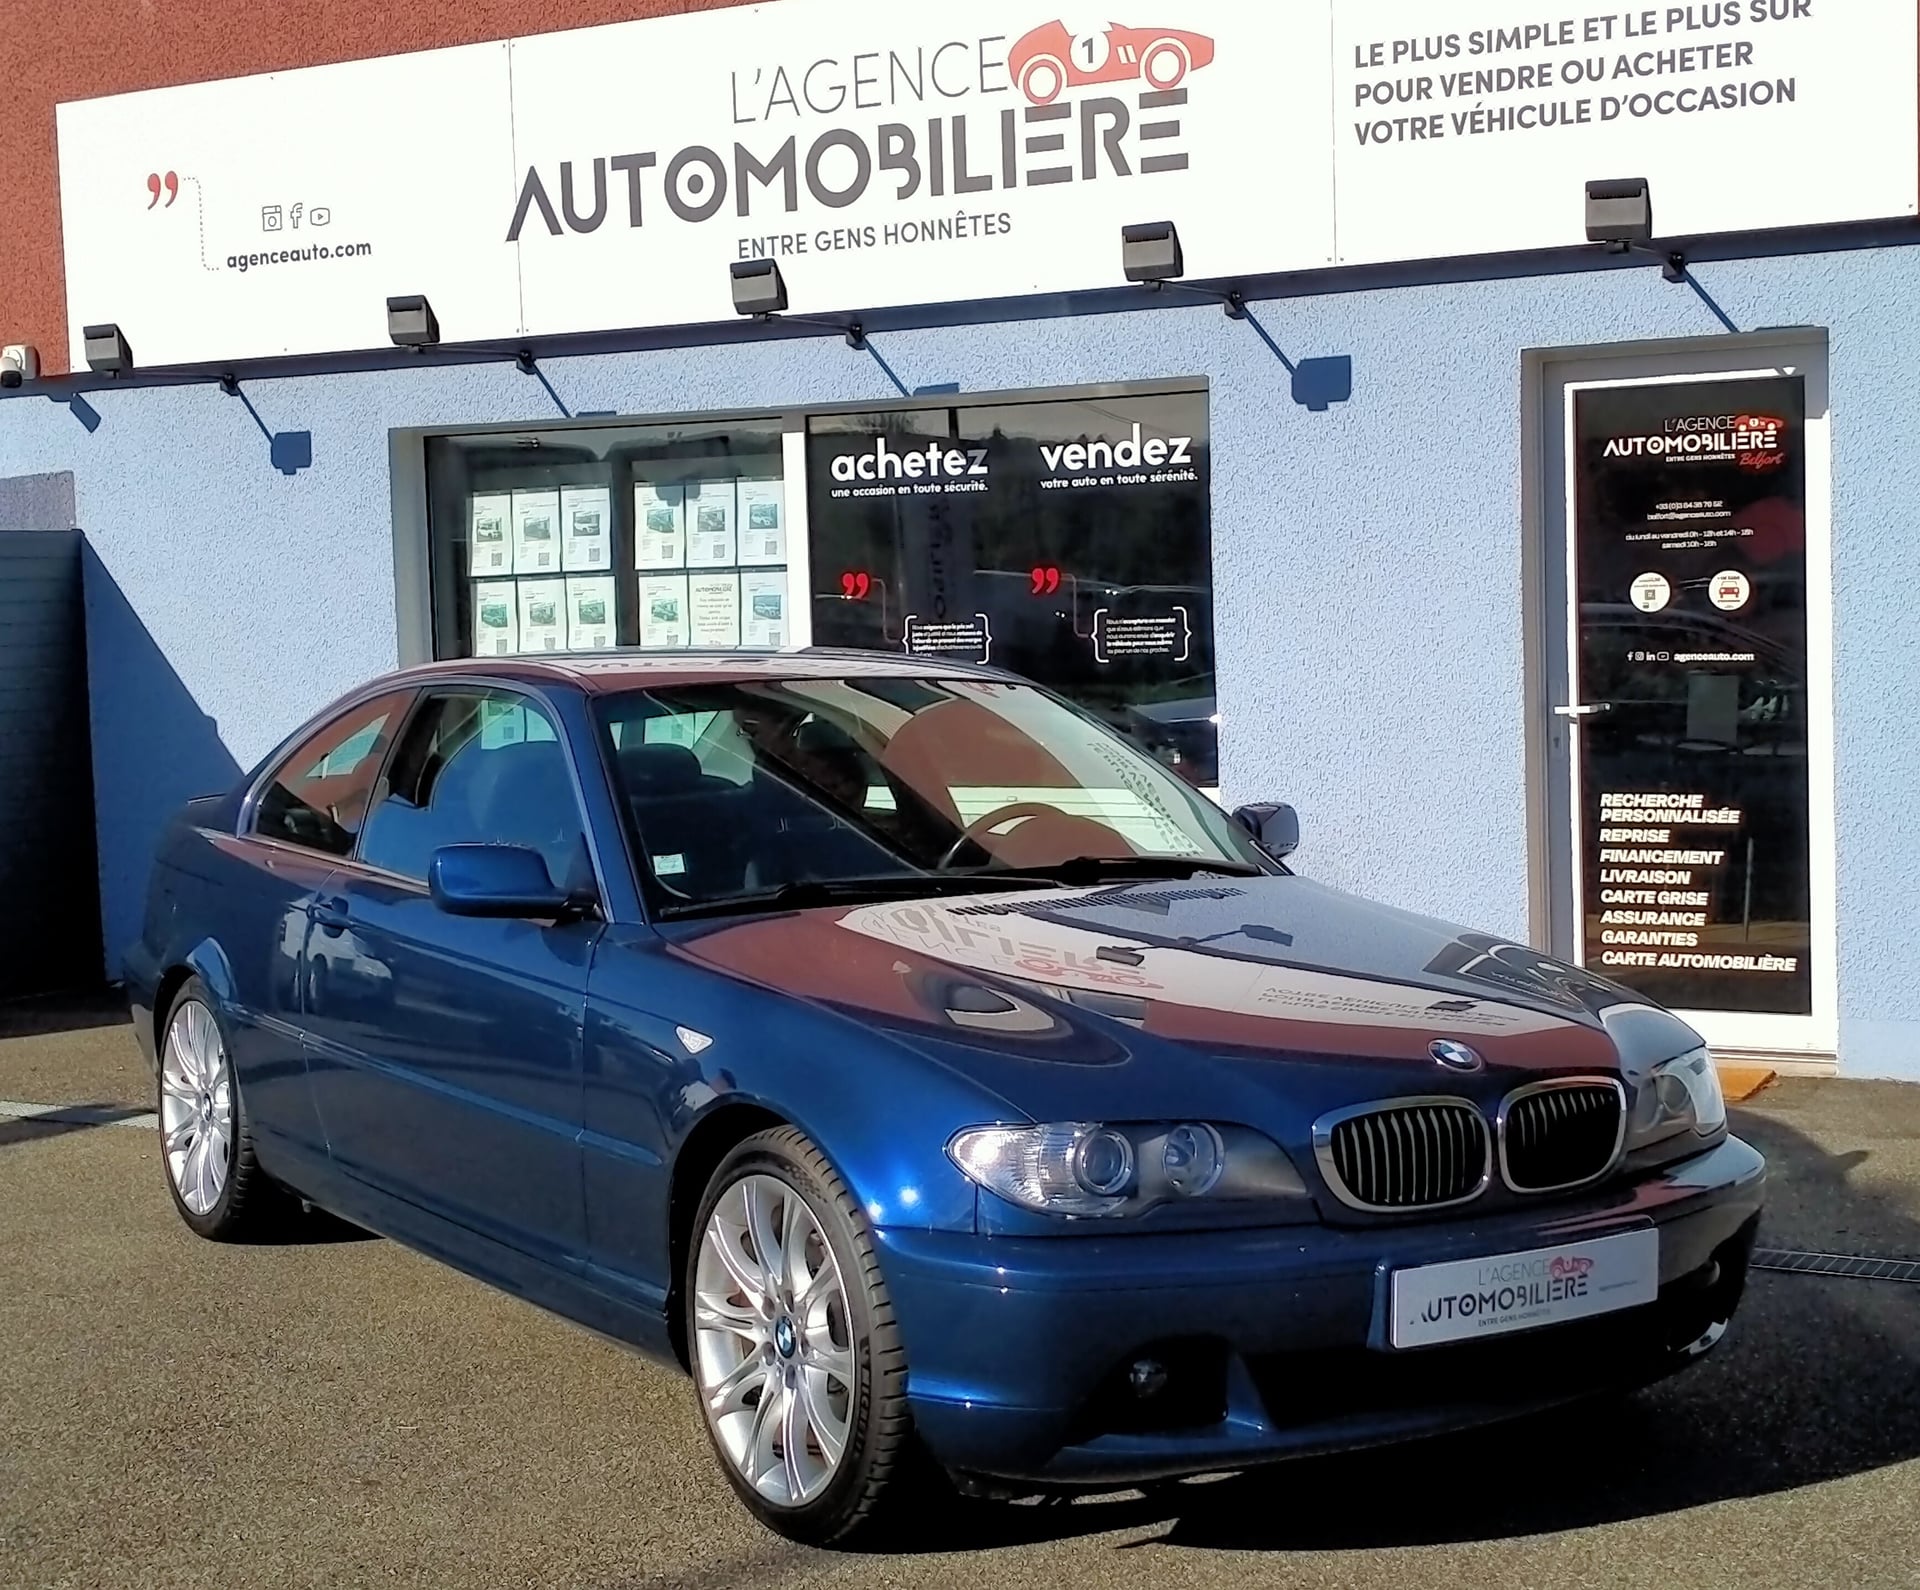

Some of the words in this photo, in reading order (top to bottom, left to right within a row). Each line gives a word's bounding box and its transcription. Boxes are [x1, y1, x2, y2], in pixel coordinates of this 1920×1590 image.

[1355, 42, 1385, 69] LE
[1392, 34, 1461, 65] PLUS
[1469, 20, 1575, 56] SIMPLE
[1584, 14, 1618, 43] ET
[1625, 11, 1658, 38] LE
[1667, 1, 1741, 33] PLUS
[1750, 0, 1812, 23] SUR
[1082, 37, 1094, 64] 1
[731, 36, 1008, 124] L'AGENCE
[1355, 77, 1433, 108] POUR
[1439, 62, 1553, 98] VENDRE
[1560, 57, 1605, 86] OU
[1611, 42, 1754, 81] ACHETER
[1354, 114, 1445, 146] VOTRE
[1450, 98, 1592, 136] VÉHICULE
[1600, 78, 1796, 121] D'OCCASION
[738, 233, 808, 260] ENTRE
[815, 226, 877, 252] GENS
[884, 212, 1011, 246] HONNÊTES
[226, 242, 372, 273] agenceauto.com
[1664, 415, 1736, 433] L'AGENCE
[1039, 422, 1192, 471] vendez
[831, 438, 988, 482] achetez
[1739, 451, 1785, 470] Belfort
[831, 489, 851, 498] une
[852, 485, 896, 497] occasion
[897, 487, 911, 495] en
[913, 483, 942, 495] toute
[944, 480, 988, 493] sécurité.
[1040, 478, 1069, 489] votre
[1071, 477, 1098, 487] auto
[1099, 477, 1114, 486] en
[1116, 474, 1147, 484] toute
[1149, 470, 1198, 483] sérénité.
[1600, 793, 1704, 808] RECHERCHE
[1600, 807, 1741, 824] PERSONNALISÉE
[1599, 829, 1671, 843] REPRISE
[1599, 849, 1725, 865] FINANCEMENT
[1599, 869, 1692, 885] LIVRAISON
[1600, 889, 1657, 905] CARTE
[1657, 890, 1709, 906] GRISE
[1599, 910, 1706, 926] ASSURANCE
[1601, 930, 1699, 946] GARANTIES
[1601, 951, 1658, 967] CARTE
[1657, 953, 1797, 972] AUTOMOBILIÈRE
[1478, 1258, 1550, 1287] L'AGENCE
